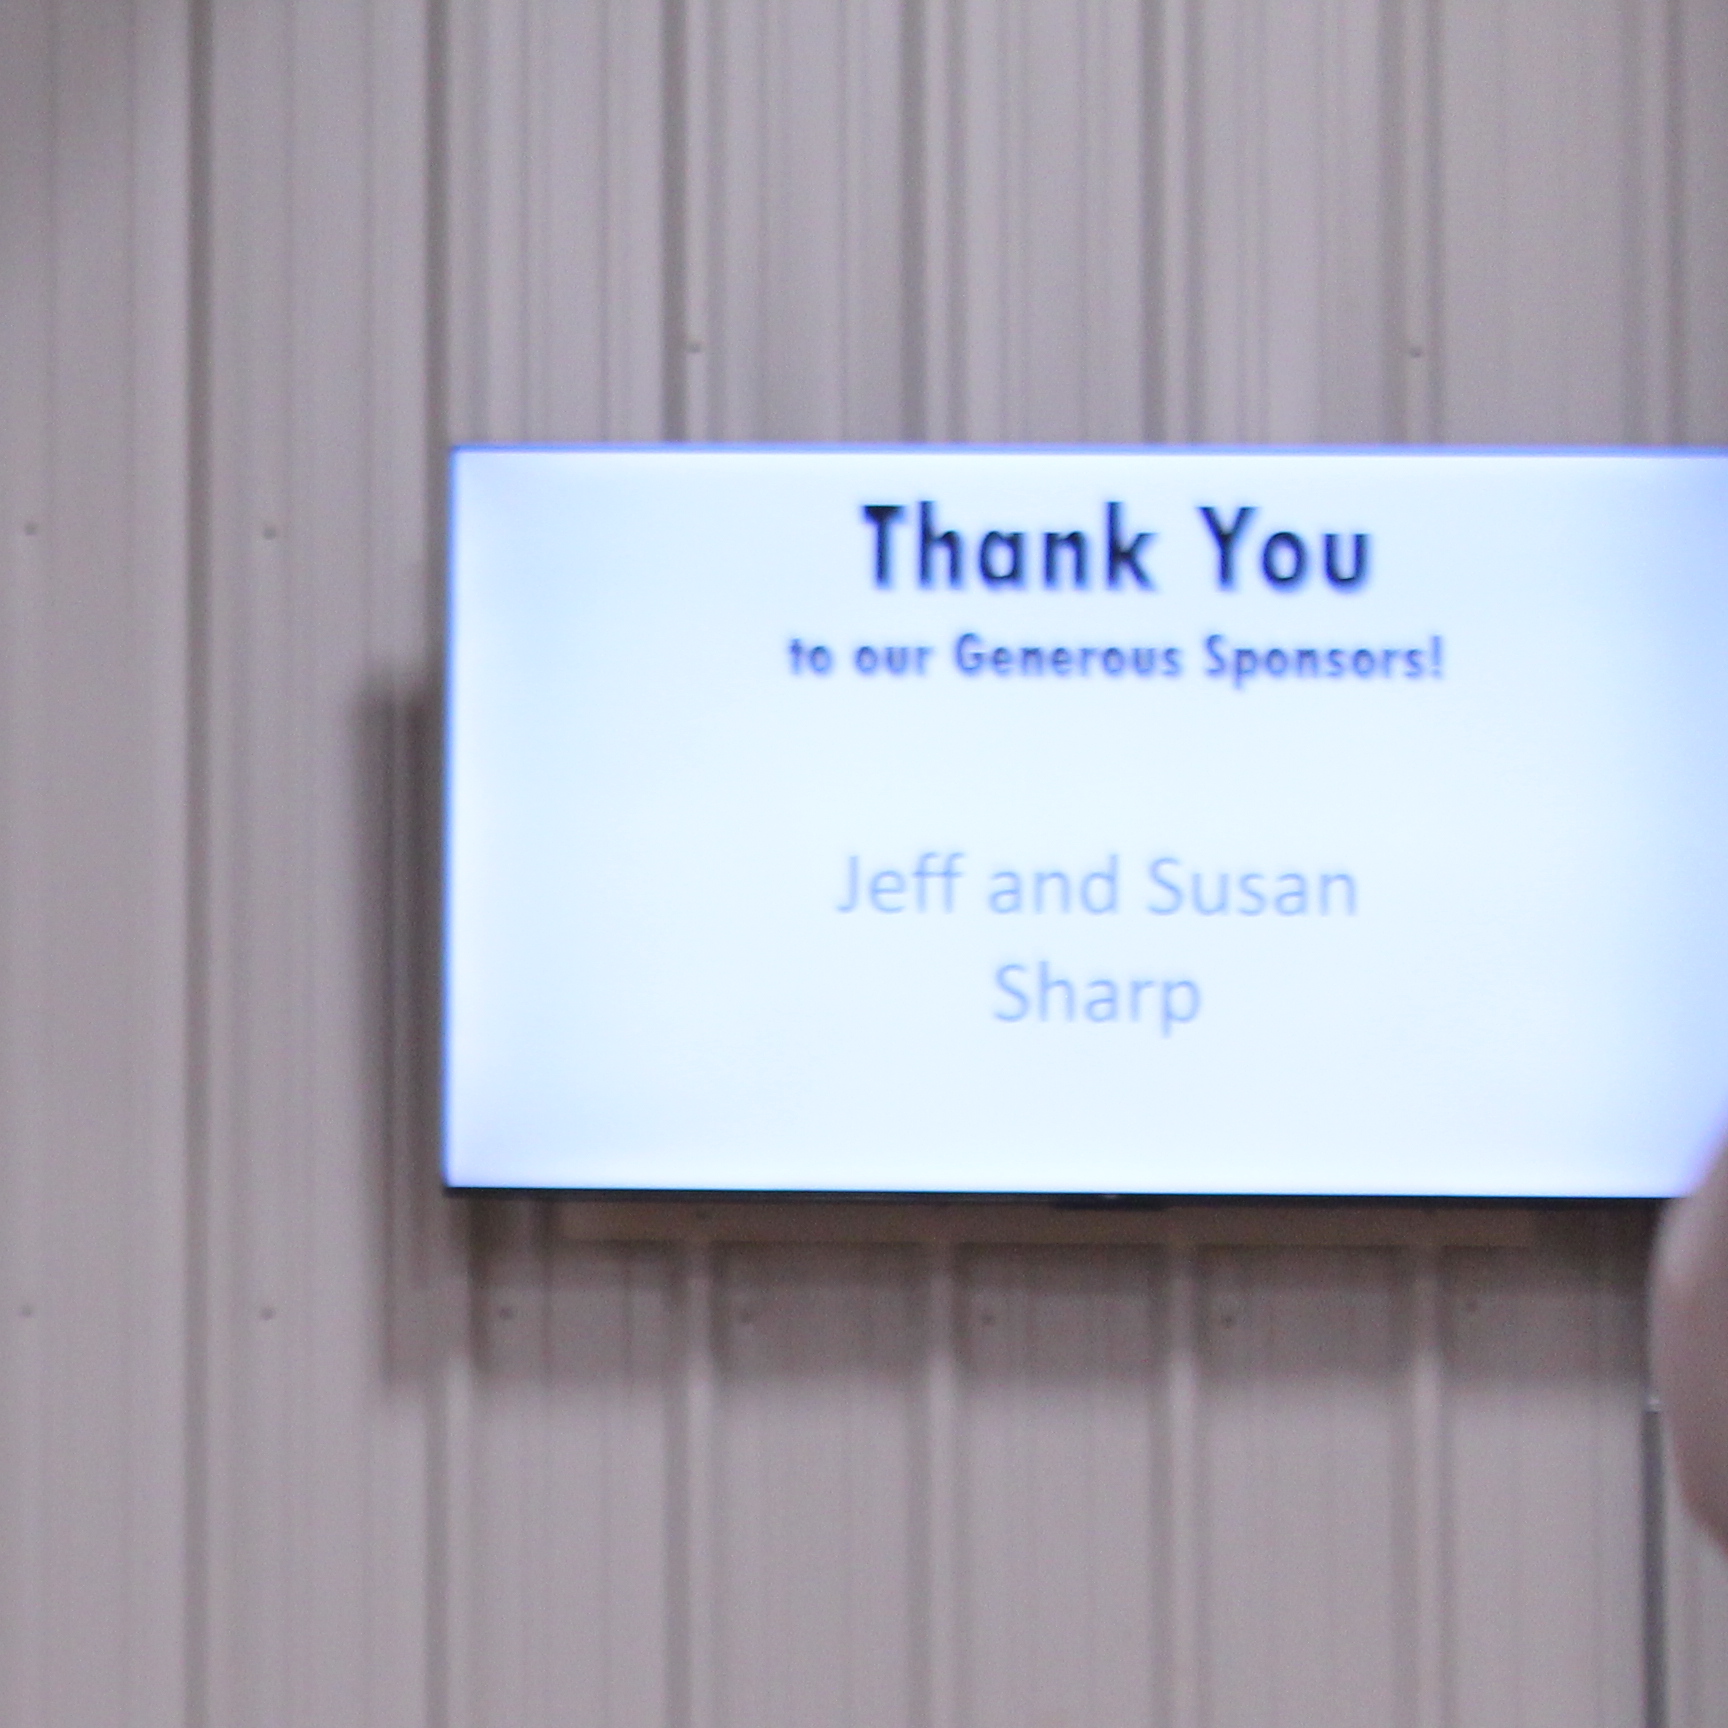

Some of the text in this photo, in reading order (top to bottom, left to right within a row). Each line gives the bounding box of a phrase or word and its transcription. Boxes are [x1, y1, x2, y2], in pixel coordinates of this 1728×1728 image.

[859, 500, 1372, 592] Thank You
[787, 631, 1444, 688] to our Generous Sponsors!
[836, 851, 1359, 917] Jeff and Susan
[992, 960, 1203, 1038] Sharp
